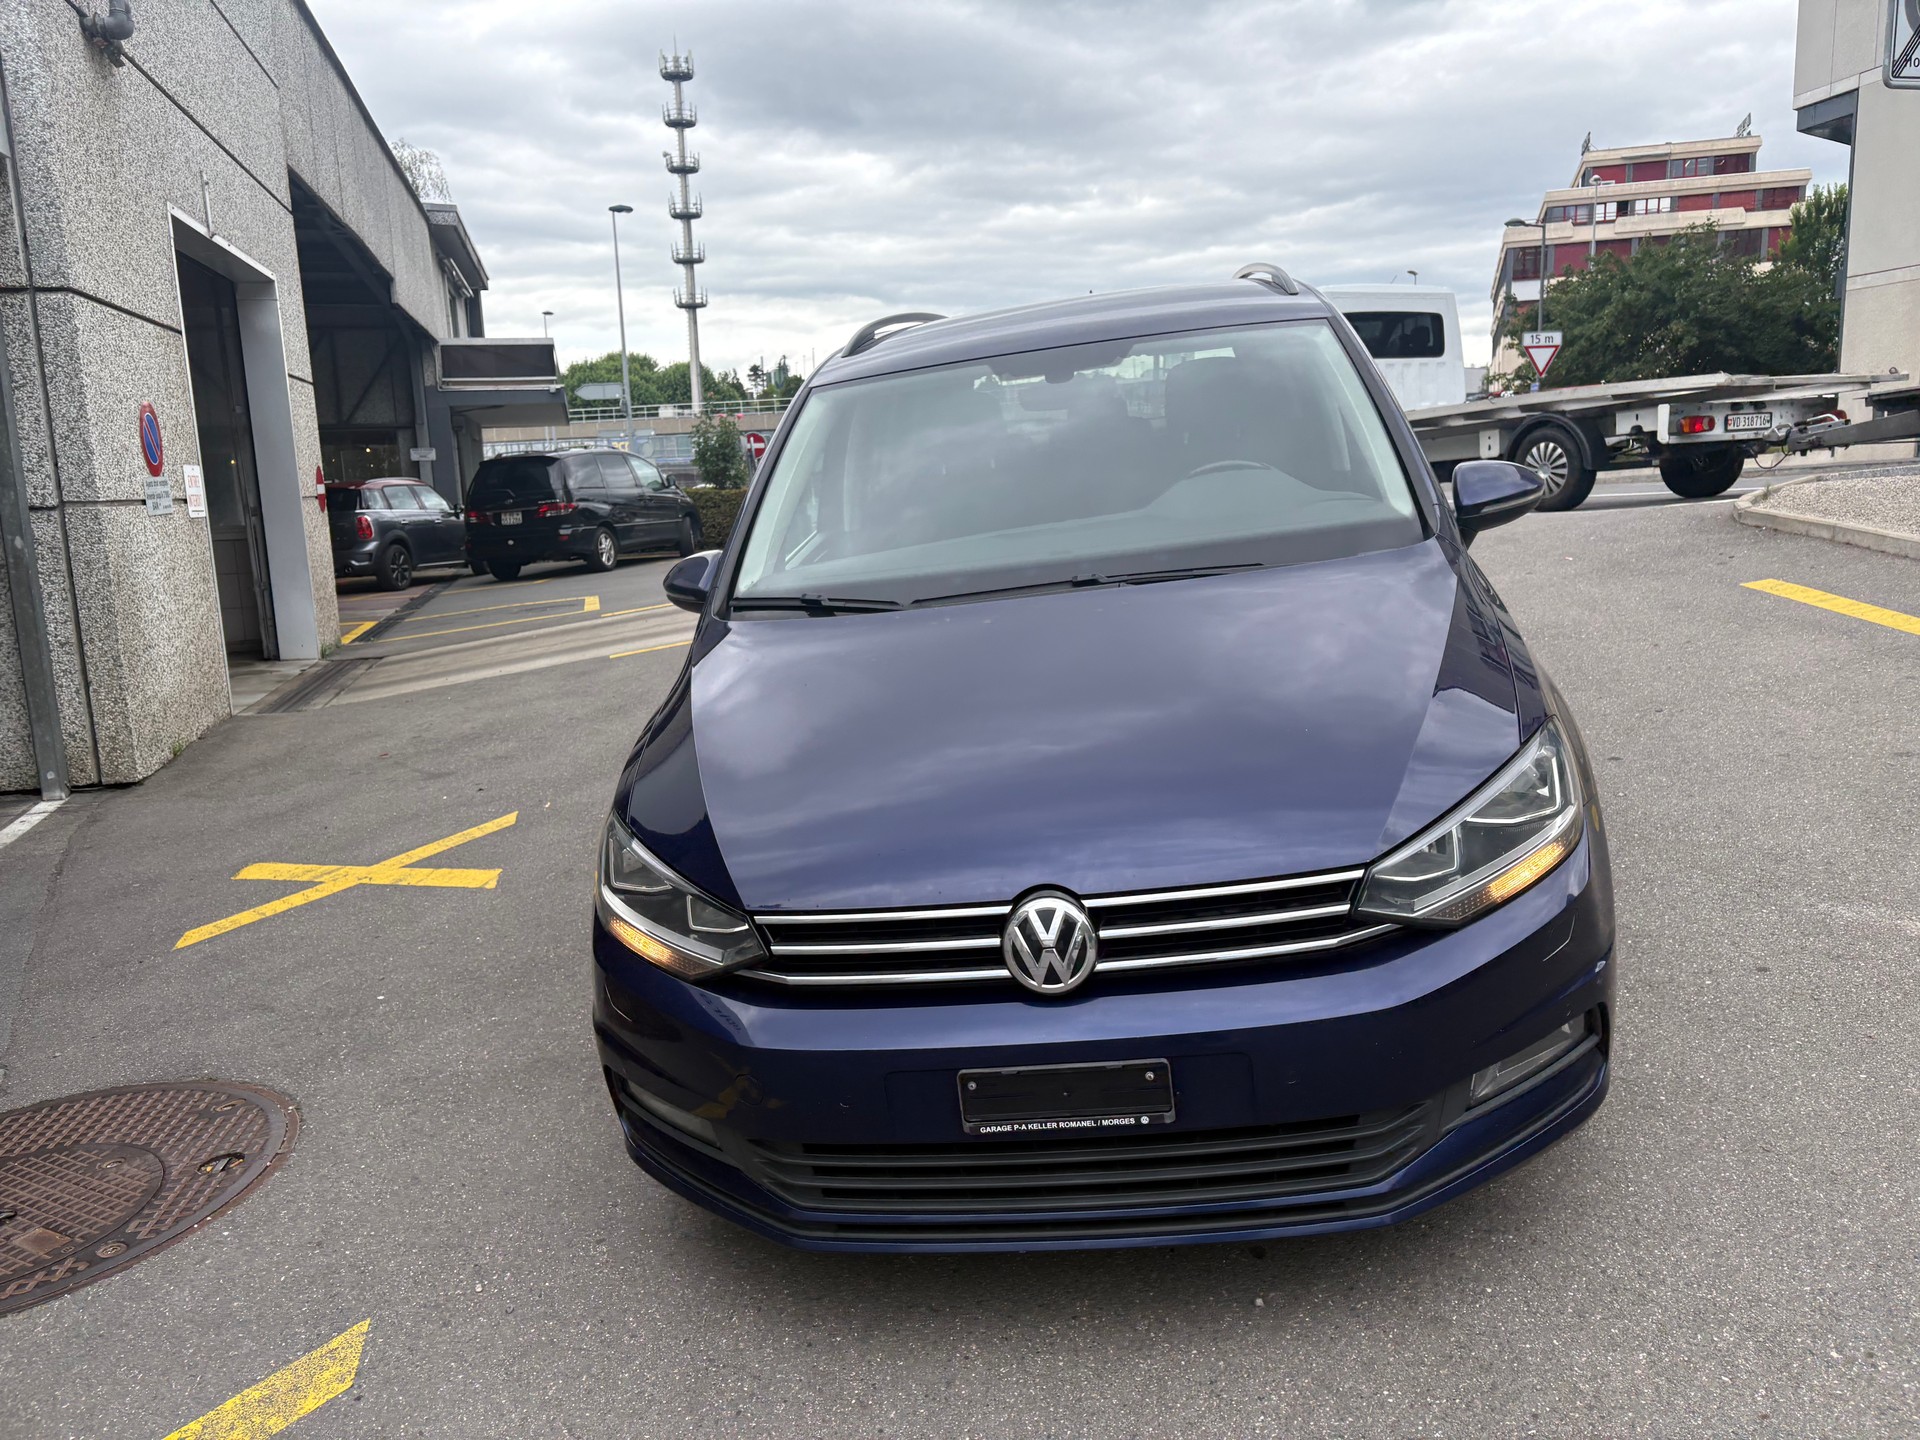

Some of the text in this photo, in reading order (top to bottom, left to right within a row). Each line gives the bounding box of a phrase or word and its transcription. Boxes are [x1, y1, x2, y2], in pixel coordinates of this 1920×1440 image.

[1530, 334, 1554, 345] 15 m
[1732, 415, 1767, 427] VD 318716
[1008, 902, 1092, 990] VW
[980, 1124, 1012, 1133] GARAGE
[1013, 1123, 1027, 1131] P-A
[1028, 1121, 1057, 1130] KELLER
[1059, 1119, 1097, 1128] ROMANEL
[1102, 1117, 1135, 1126] MORGES
